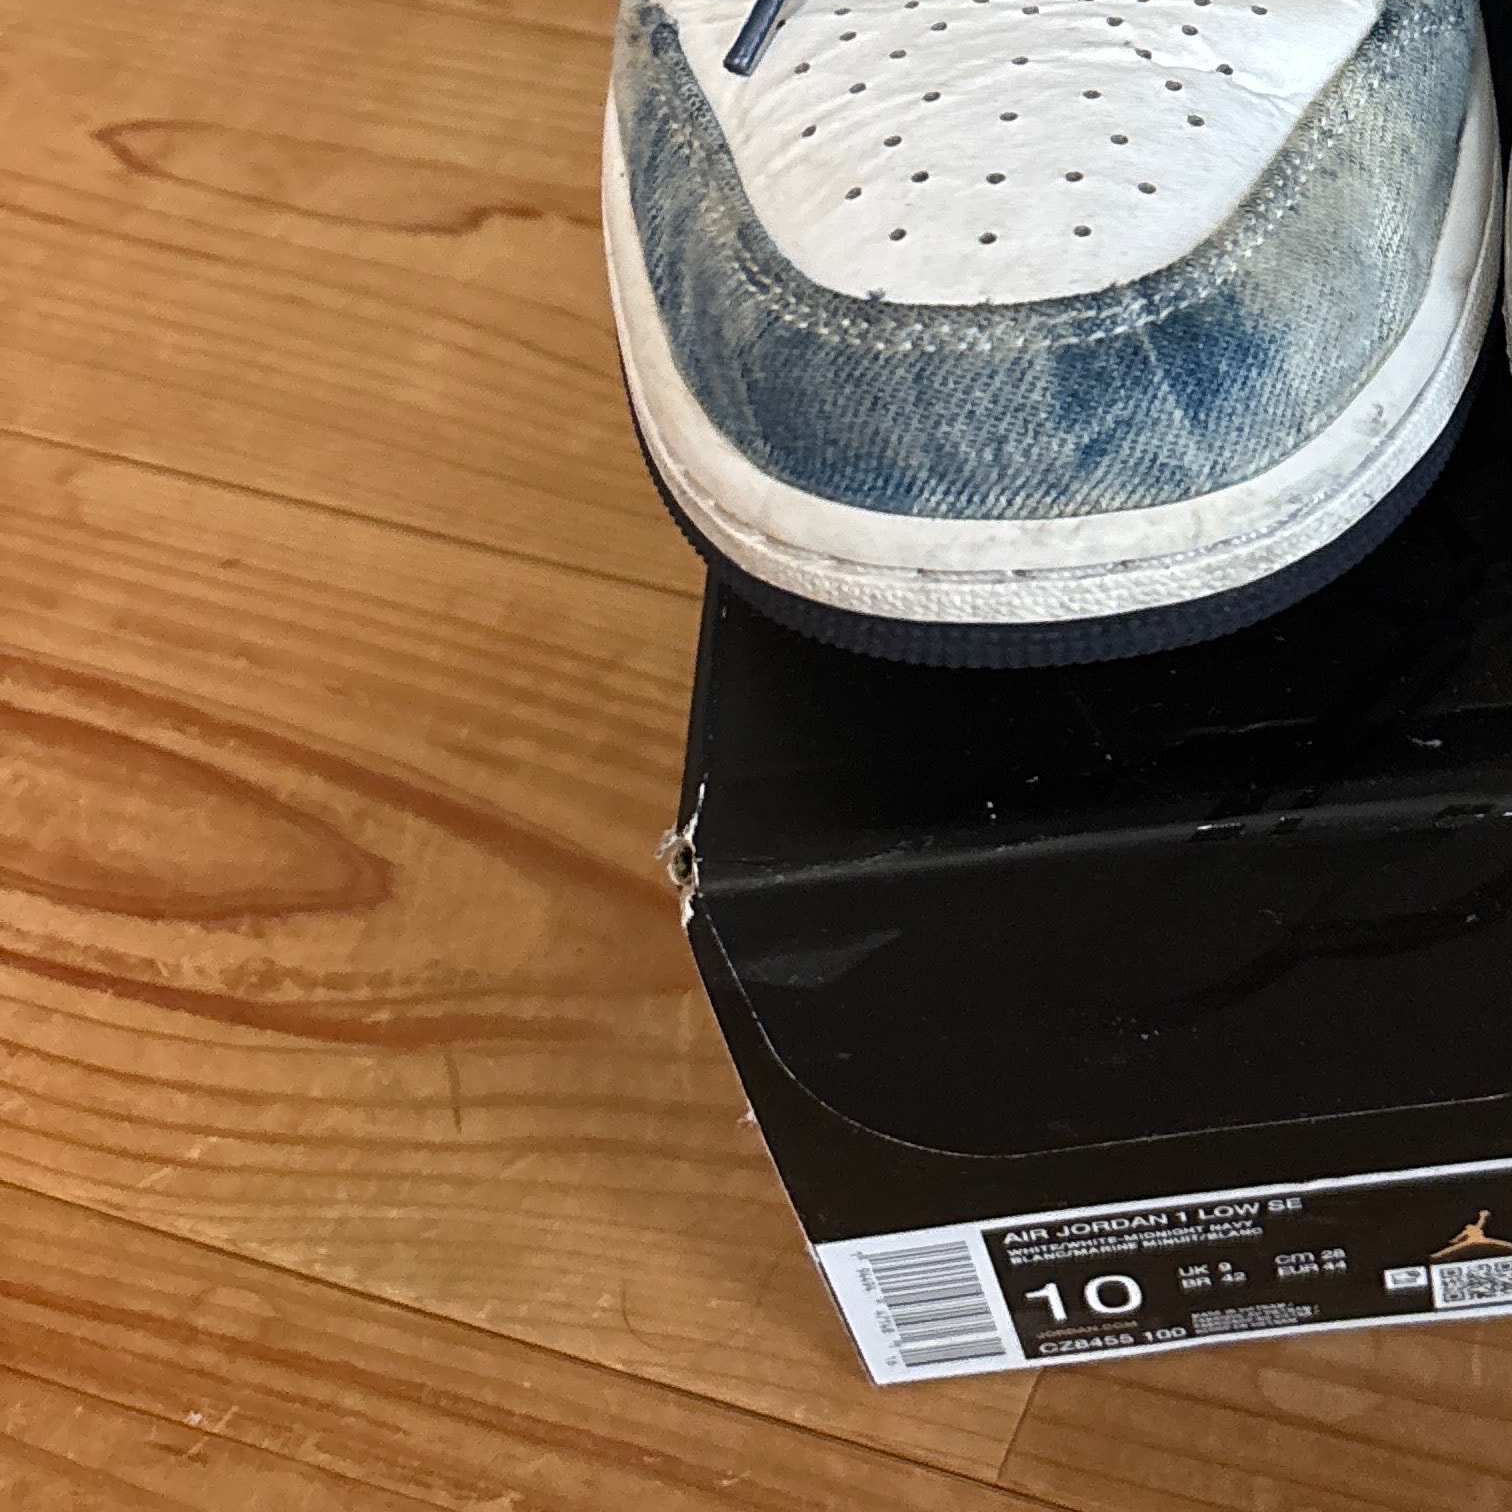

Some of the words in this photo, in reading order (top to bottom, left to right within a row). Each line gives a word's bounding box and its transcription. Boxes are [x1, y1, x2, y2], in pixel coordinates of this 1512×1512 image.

[1003, 1228, 1049, 1245] AIR
[1056, 1213, 1168, 1238] JORDAN
[1176, 1210, 1188, 1223] 1
[1198, 1202, 1260, 1220] LOW
[1268, 1197, 1303, 1212] SE
[1209, 1220, 1253, 1232] NAVY
[1178, 1264, 1210, 1278] UK
[1025, 1274, 1143, 1322] 10
[1039, 1333, 1135, 1355] CZ8455
[1142, 1326, 1187, 1342] 100
